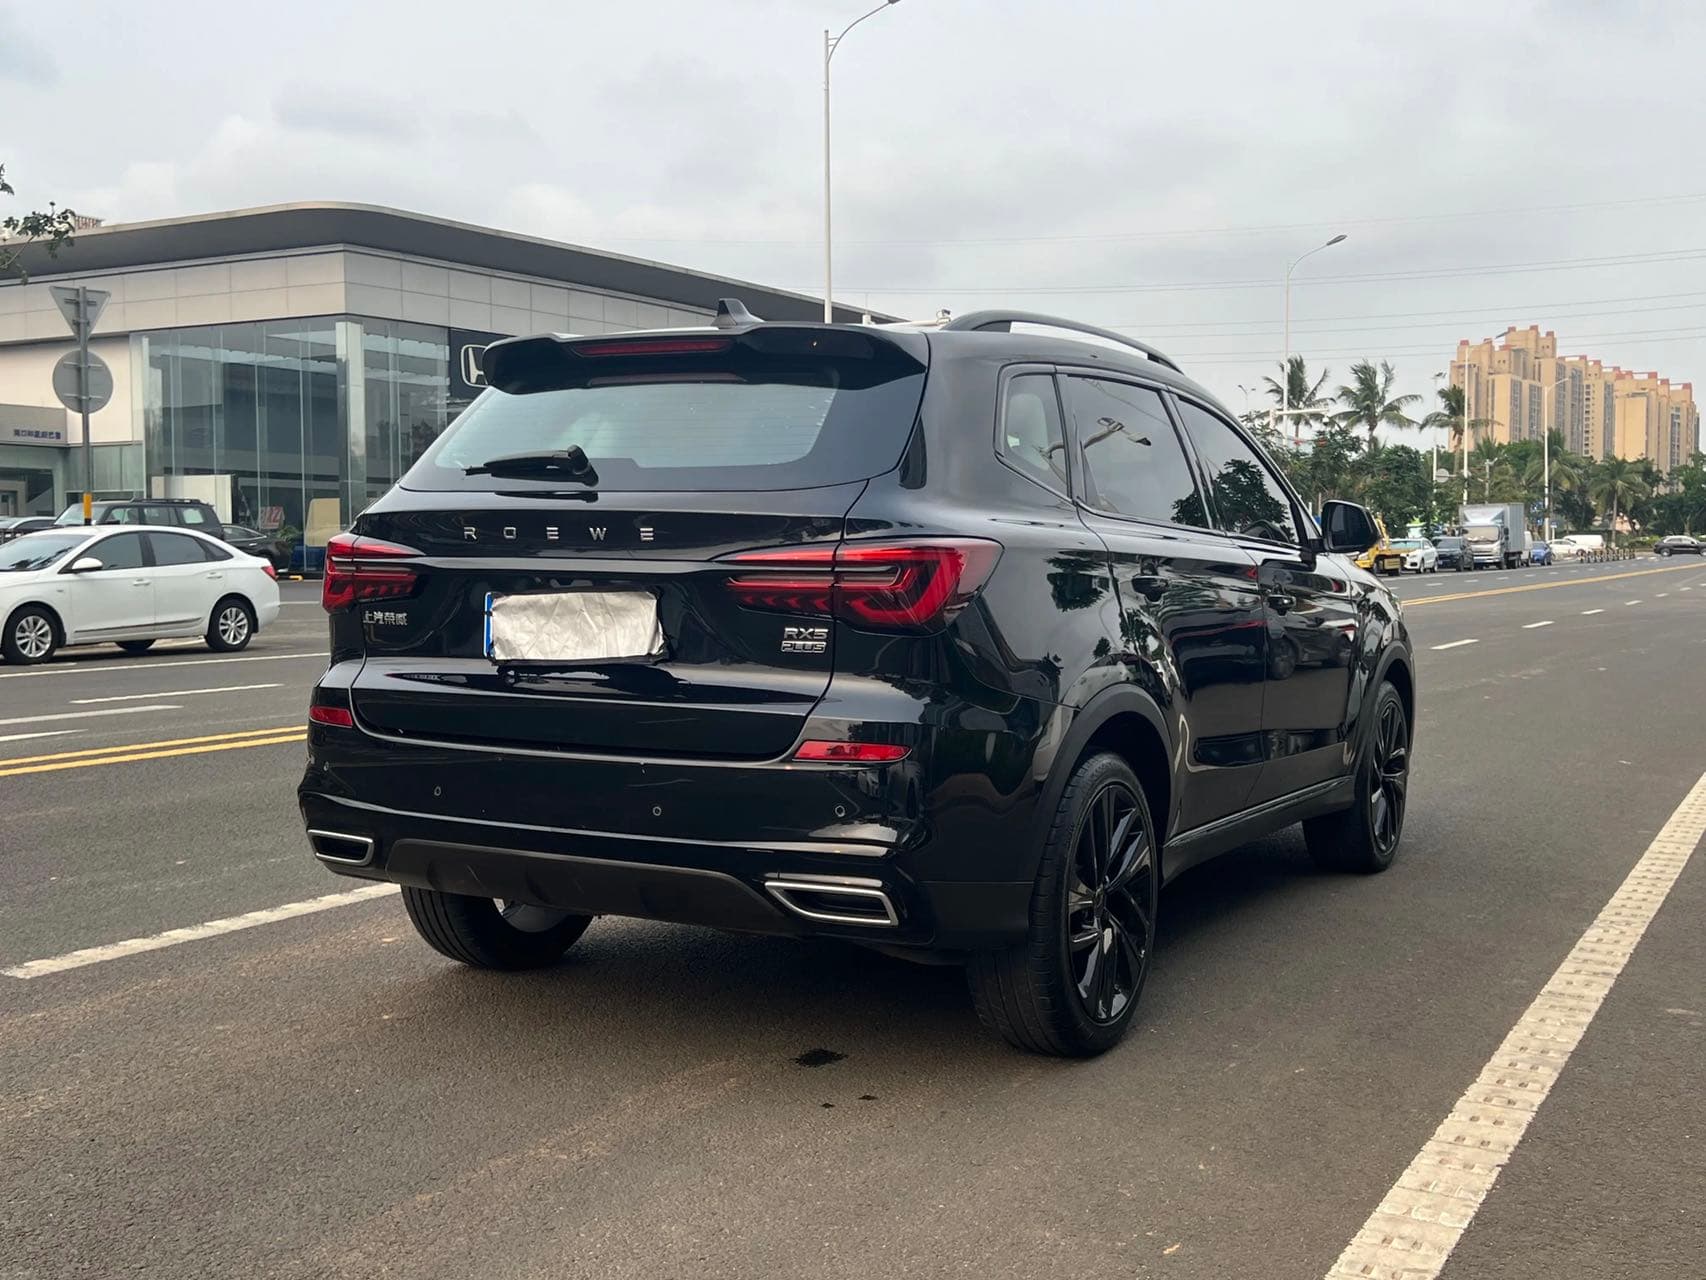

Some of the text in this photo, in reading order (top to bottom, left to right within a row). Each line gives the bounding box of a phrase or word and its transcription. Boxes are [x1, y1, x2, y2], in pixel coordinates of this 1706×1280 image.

[463, 526, 654, 541] ROEWE
[362, 610, 408, 626] 上汽荣威
[784, 627, 829, 639] RX5
[782, 641, 827, 653] PLUS
